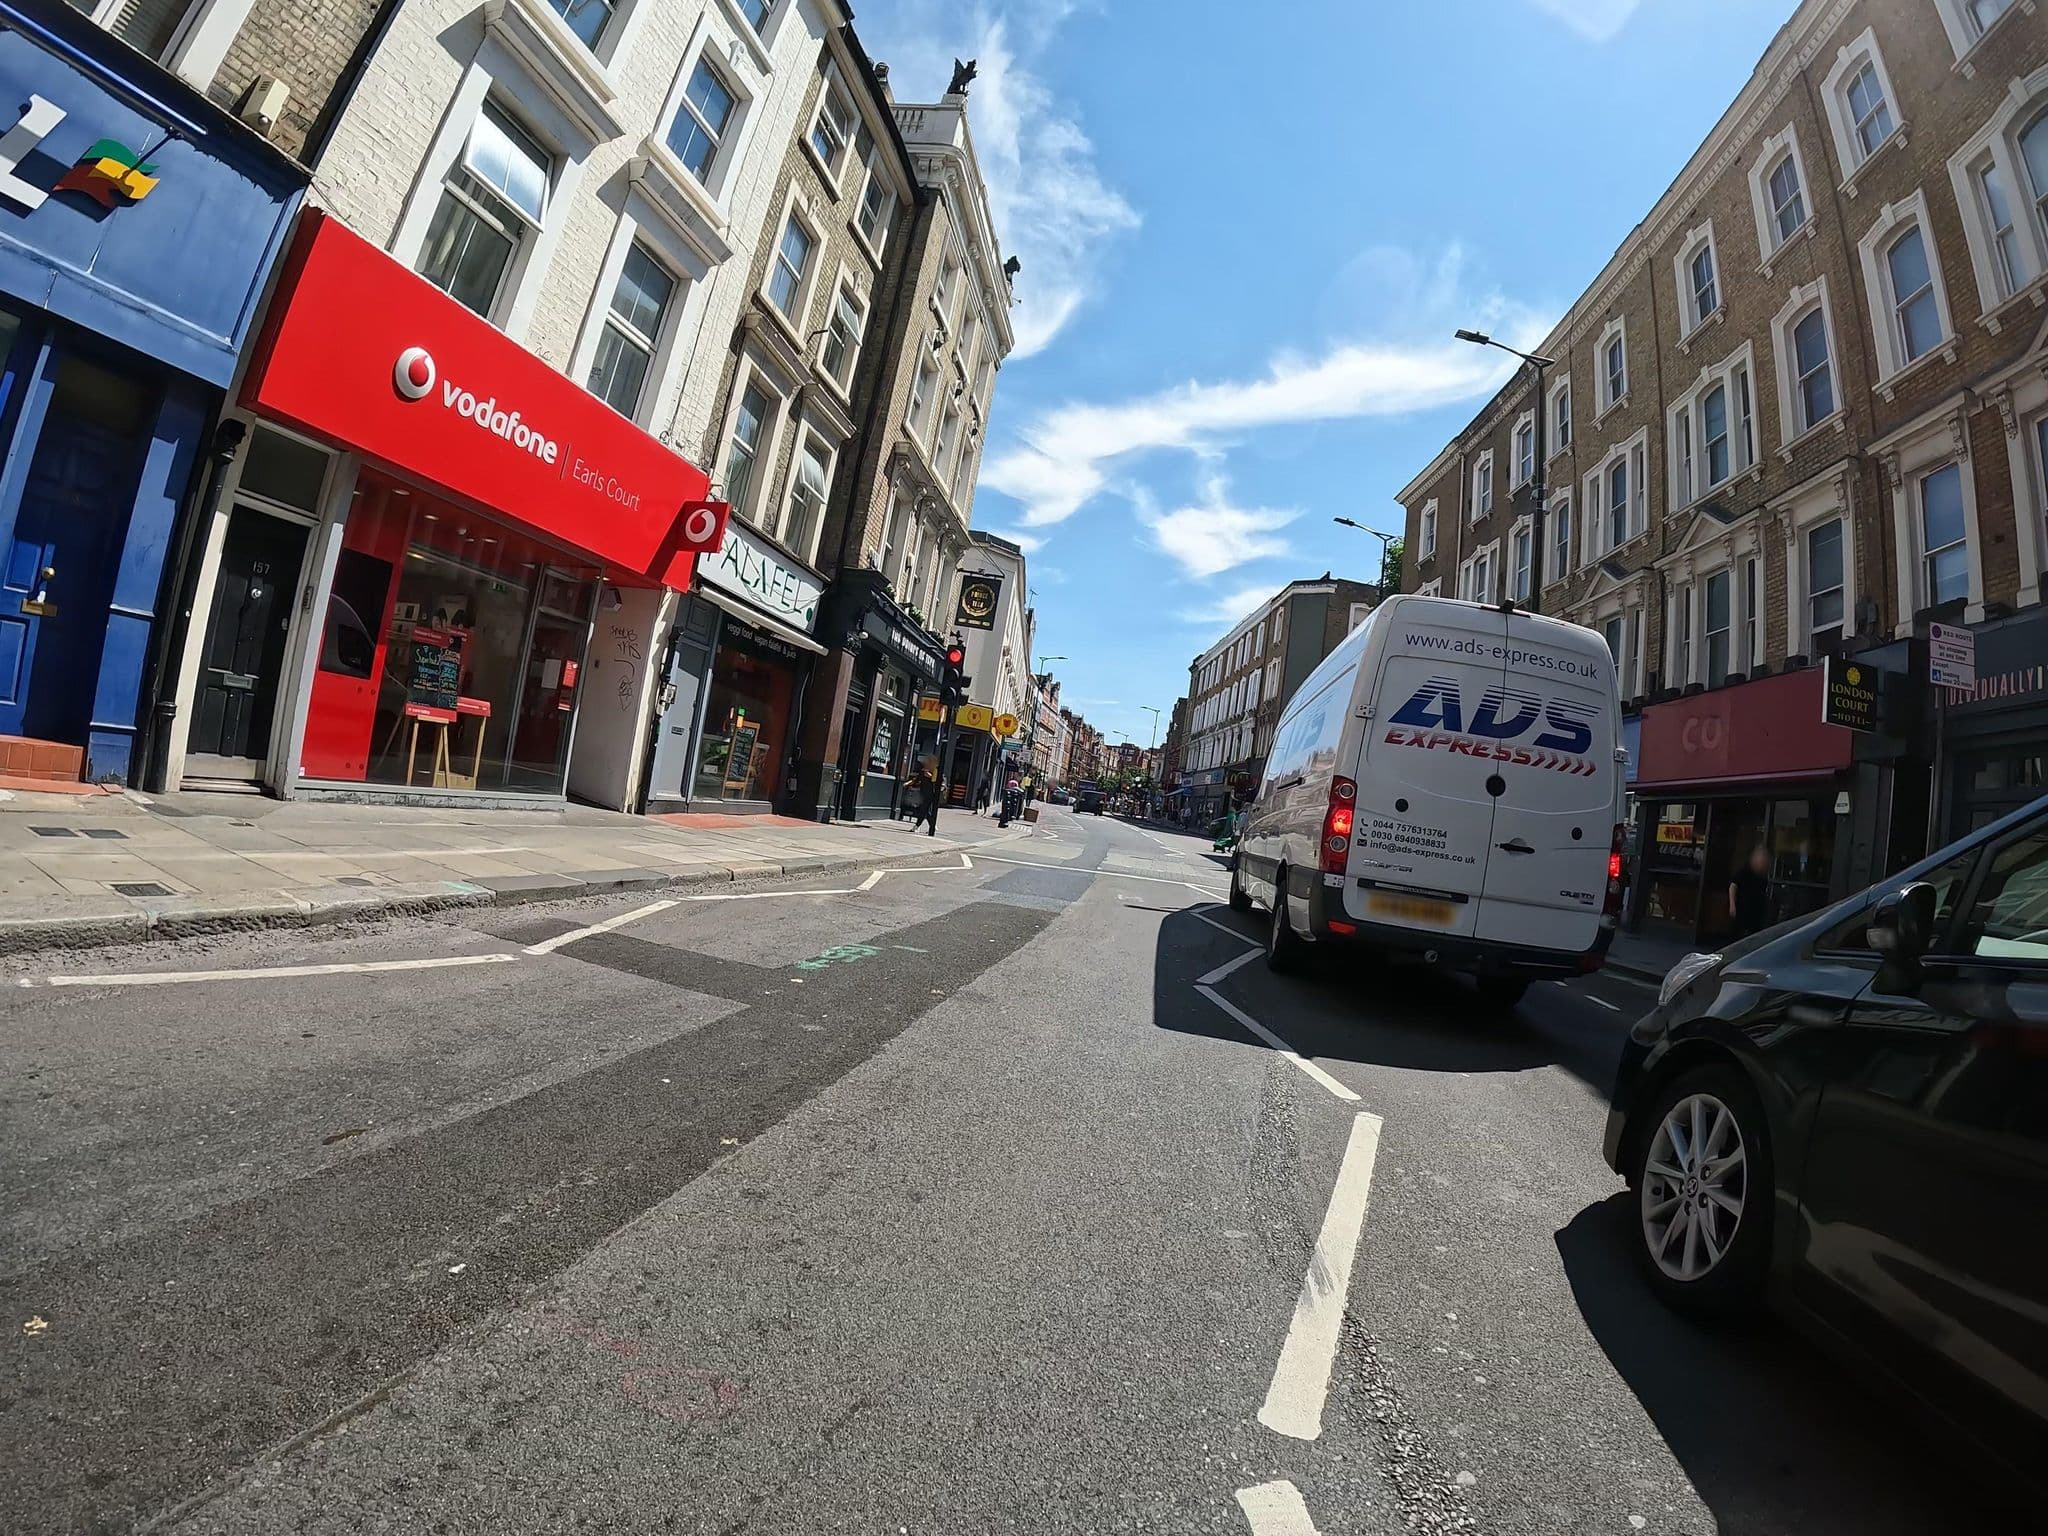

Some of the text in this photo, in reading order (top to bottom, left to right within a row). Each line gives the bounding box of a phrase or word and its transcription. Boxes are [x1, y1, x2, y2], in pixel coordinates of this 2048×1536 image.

[442, 379, 558, 465] vodafone
[573, 458, 641, 512] Earls Court
[252, 560, 270, 574] 157
[1405, 633, 1598, 680] www.ads-express.co.uk
[1831, 682, 1875, 701] LONDON
[1835, 696, 1869, 713] COURT
[1934, 667, 2034, 709] IDIVIDUALLY
[1388, 675, 1602, 754] ADS
[1384, 728, 1531, 766] EXPRESS
[1371, 830, 1446, 850] 0030 6940938833
[1372, 819, 1448, 839] 0044 7576313764
